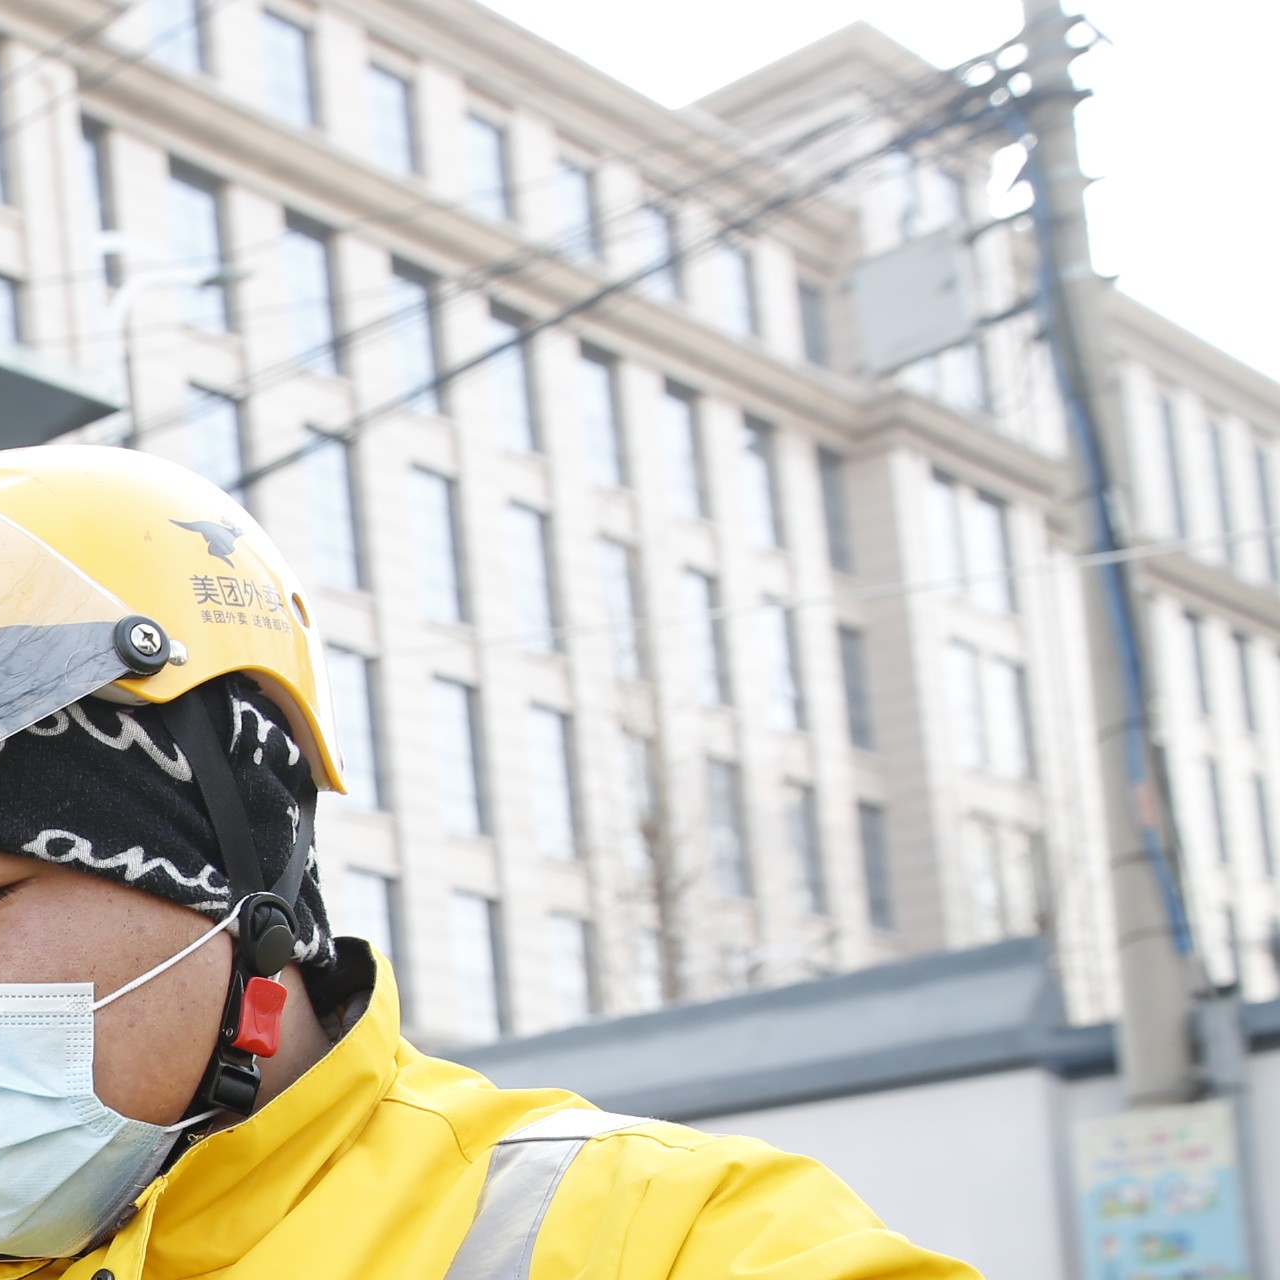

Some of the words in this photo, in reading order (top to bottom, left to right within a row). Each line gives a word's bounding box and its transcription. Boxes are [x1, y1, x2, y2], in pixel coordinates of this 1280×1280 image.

[189, 574, 286, 613] 美团外卖
[201, 609, 249, 626] 美团外卖
